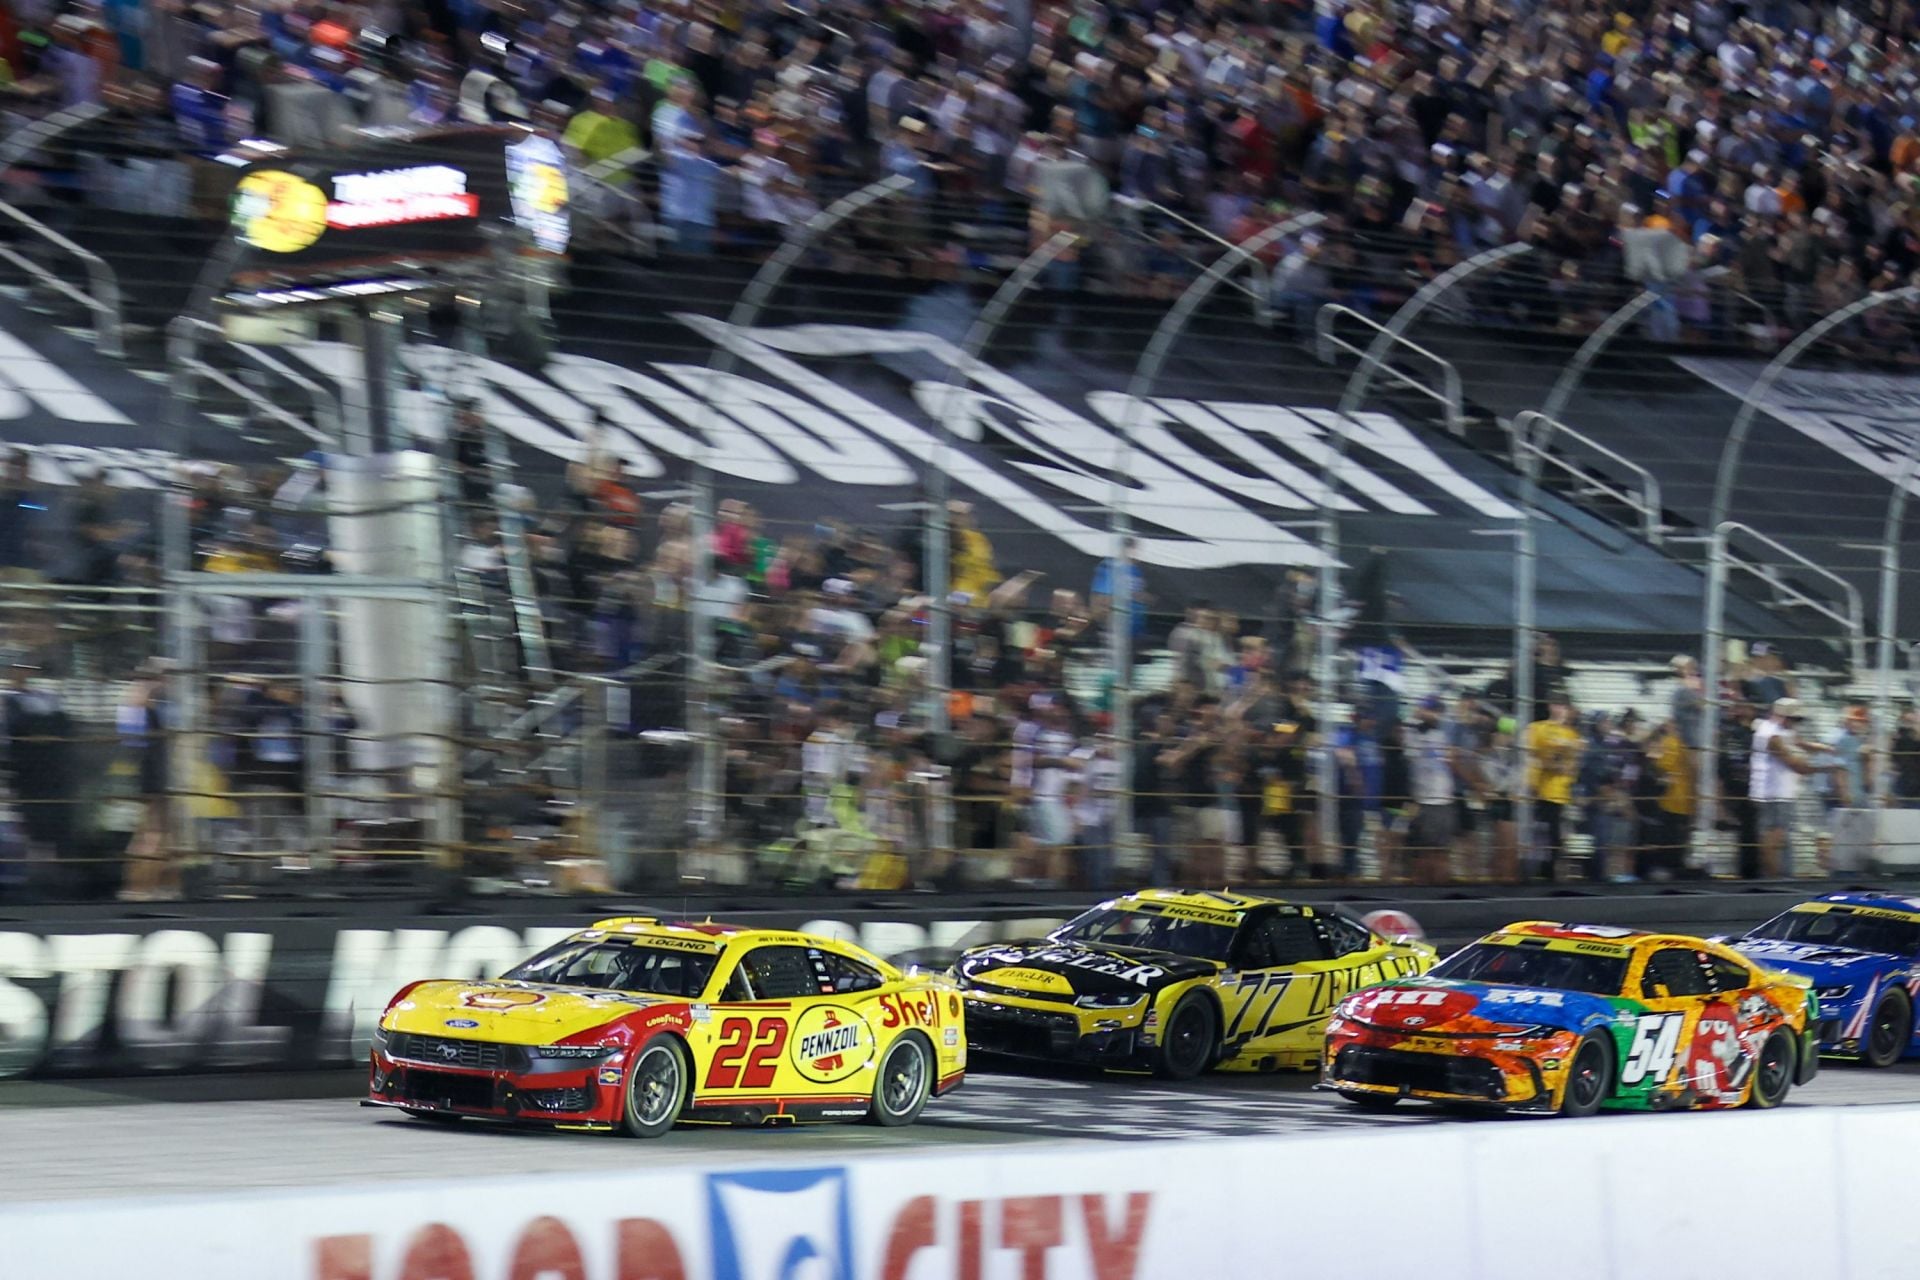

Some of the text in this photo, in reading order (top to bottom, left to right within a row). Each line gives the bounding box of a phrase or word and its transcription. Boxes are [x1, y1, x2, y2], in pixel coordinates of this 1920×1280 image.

[1168, 906, 1236, 924] HOCEVAR
[1858, 908, 1911, 921] LARSON
[647, 938, 706, 950] LOGANO
[1575, 942, 1622, 955] GIBBS
[878, 990, 940, 1029] Shell
[1226, 971, 1293, 1039] 77
[645, 1013, 684, 1028] GOODYEAR
[704, 1016, 789, 1089] 22
[800, 1024, 859, 1061] PENNZOIL
[1621, 1012, 1686, 1087] 54
